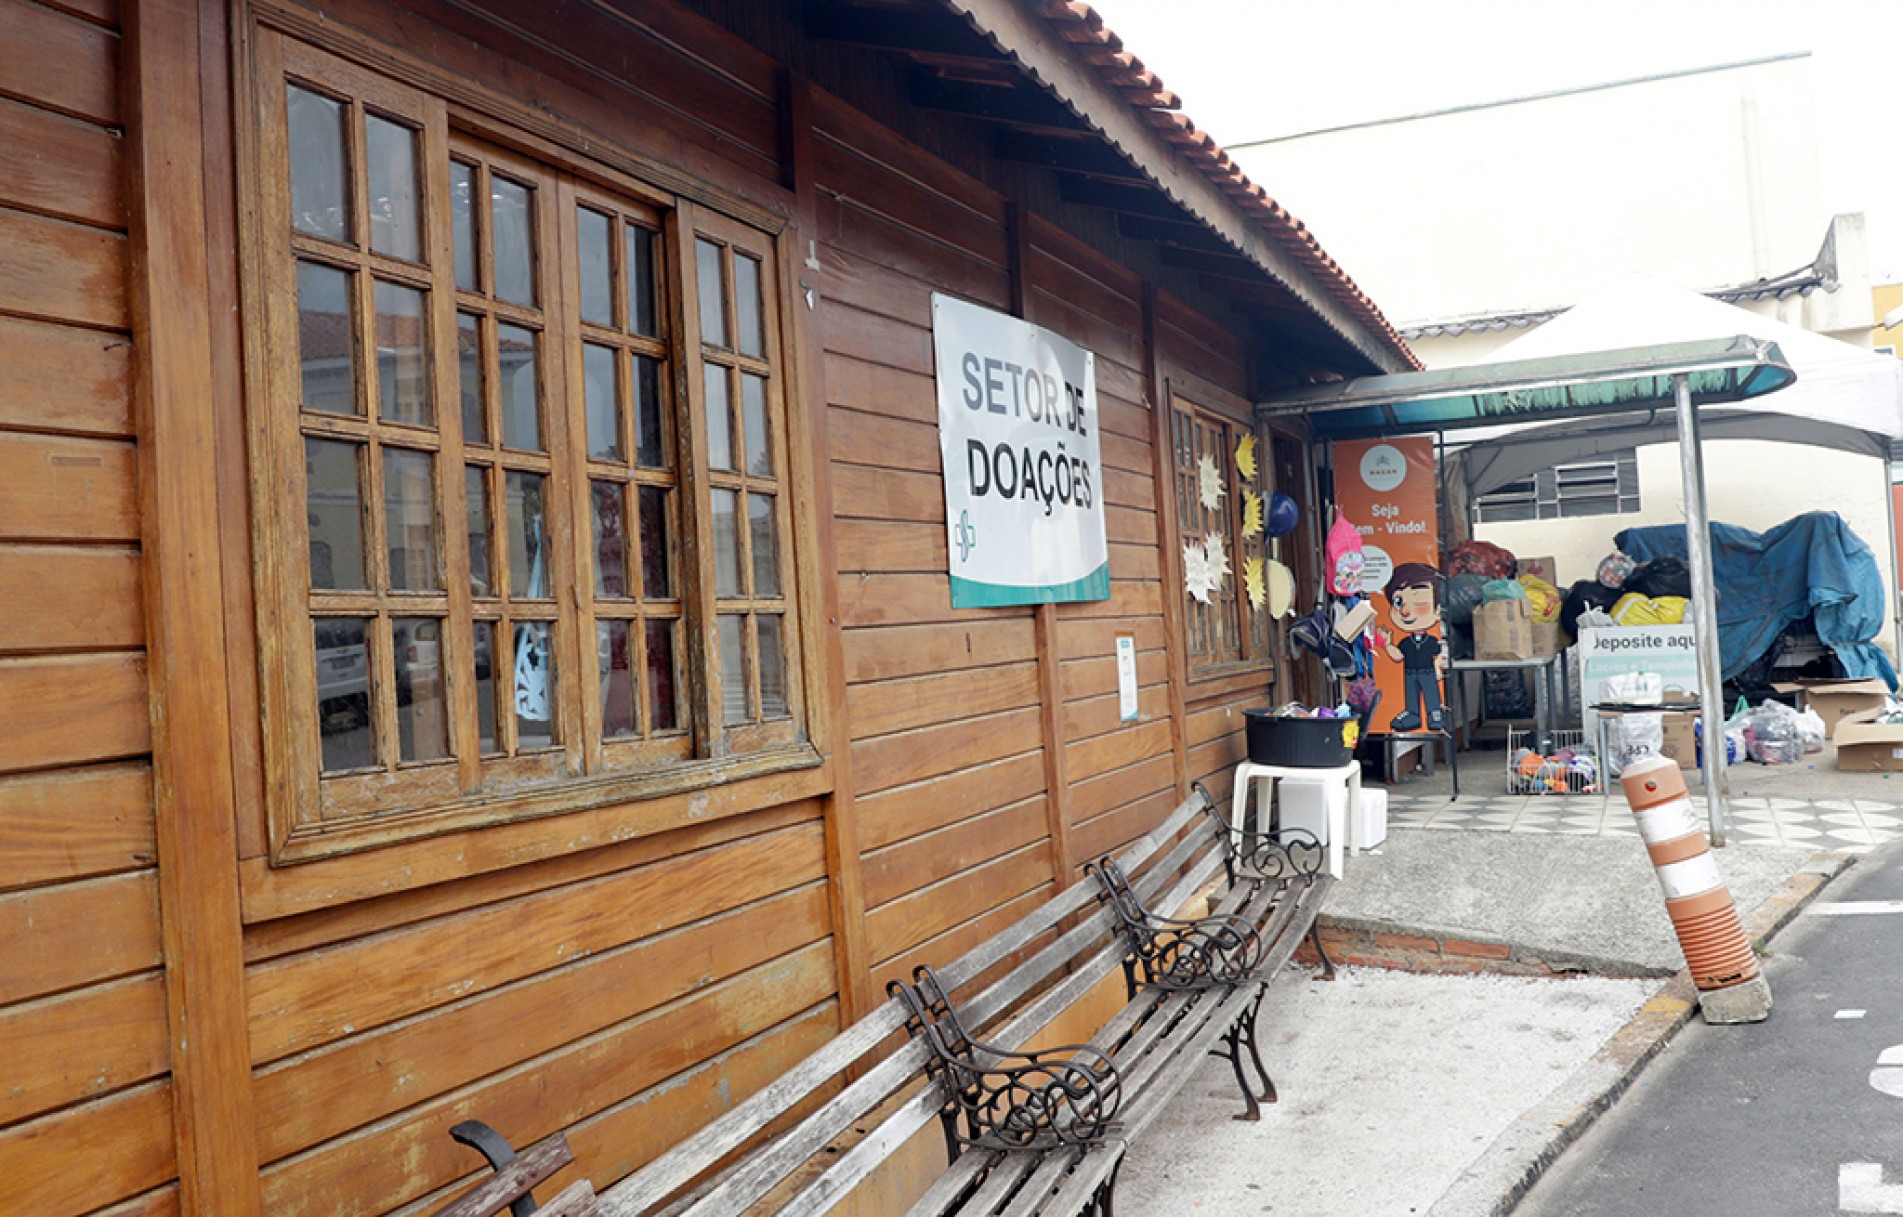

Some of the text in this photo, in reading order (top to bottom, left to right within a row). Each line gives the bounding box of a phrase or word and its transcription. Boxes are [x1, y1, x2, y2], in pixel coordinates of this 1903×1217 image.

[962, 352, 1087, 437] SETOR DE
[967, 438, 1093, 516] DOAÇÕES
[1371, 503, 1400, 519] Seja
[1352, 523, 1374, 535] em
[1385, 520, 1427, 535] Vindo!
[1667, 635, 1696, 649] aqu
